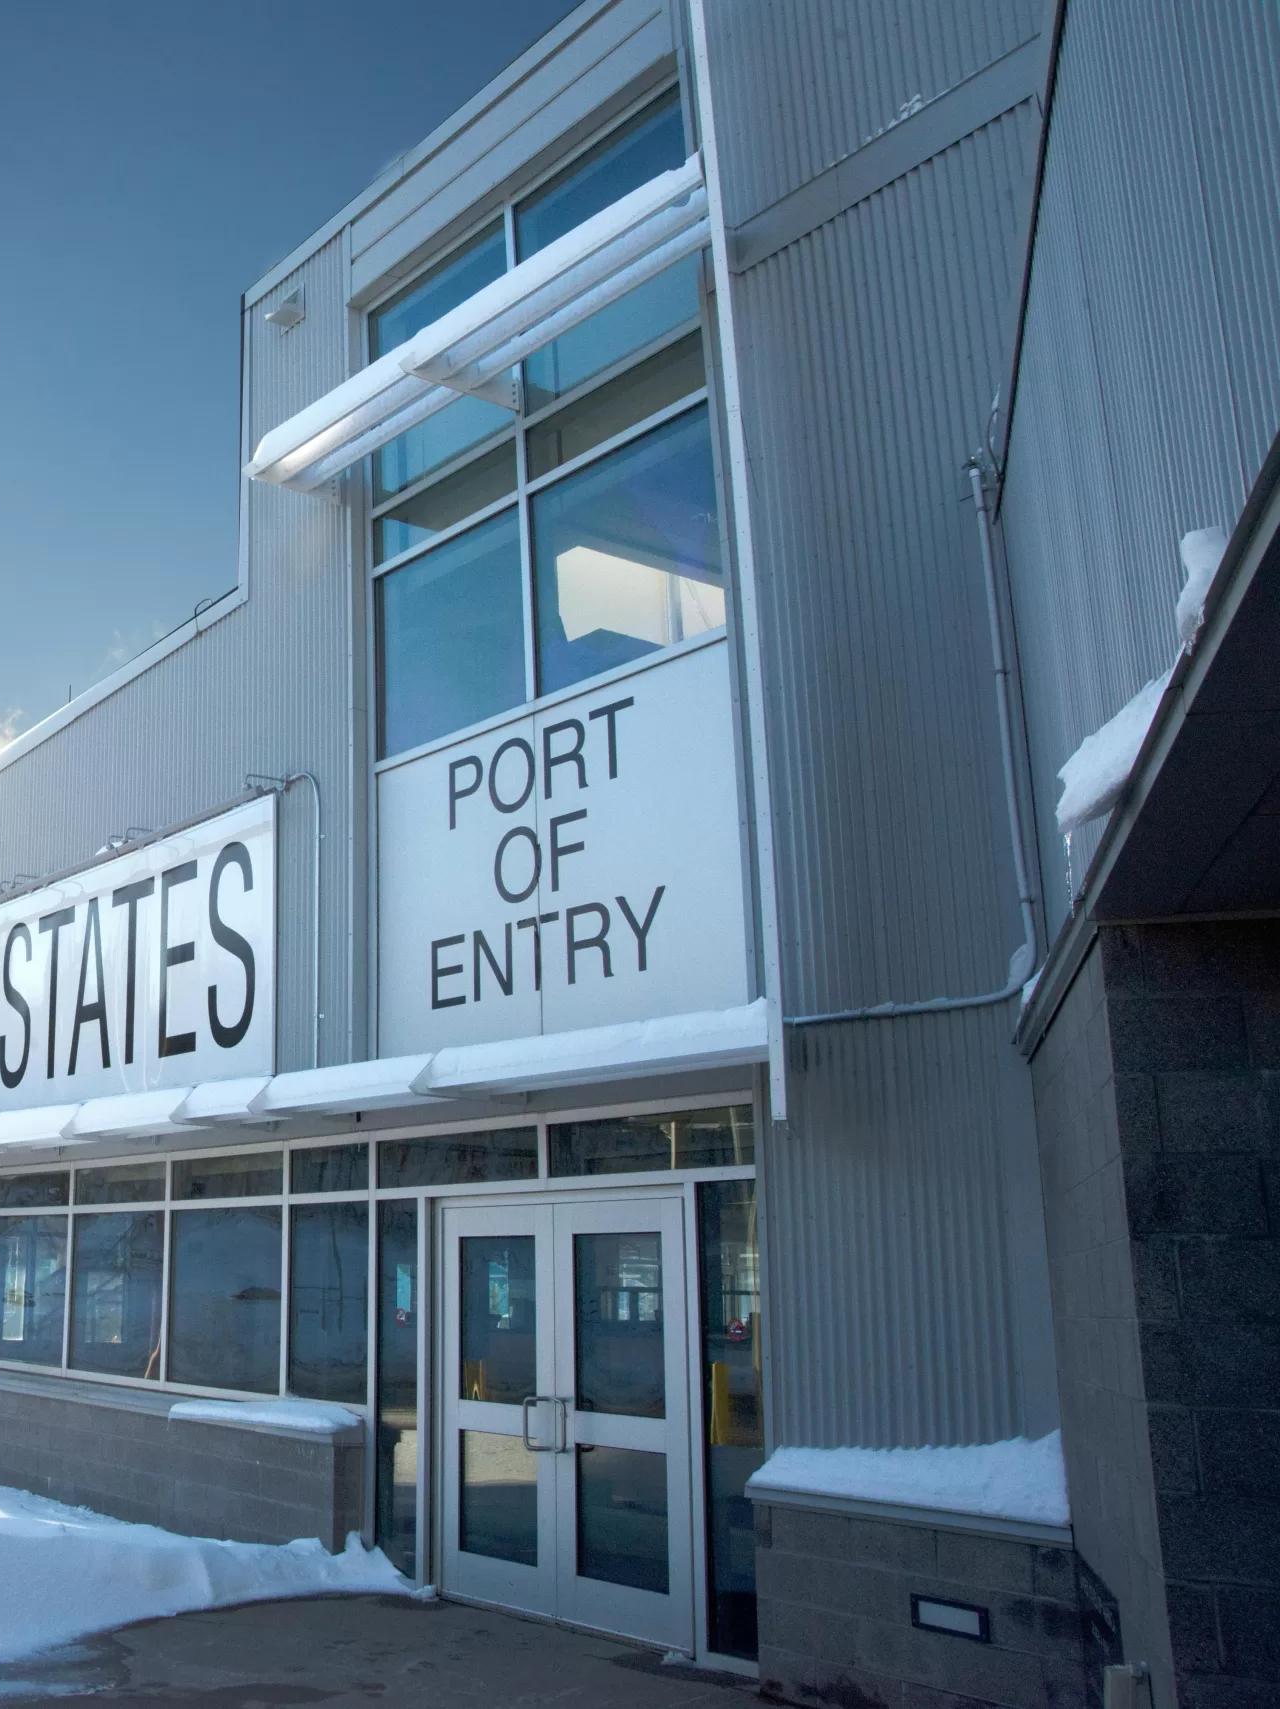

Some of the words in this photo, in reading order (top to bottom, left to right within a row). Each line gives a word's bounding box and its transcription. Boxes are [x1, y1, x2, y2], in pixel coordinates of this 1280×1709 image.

[448, 696, 635, 830] PORT
[494, 808, 588, 903] OF
[0, 841, 256, 1089] STATES
[431, 885, 666, 1010] ENTRY
